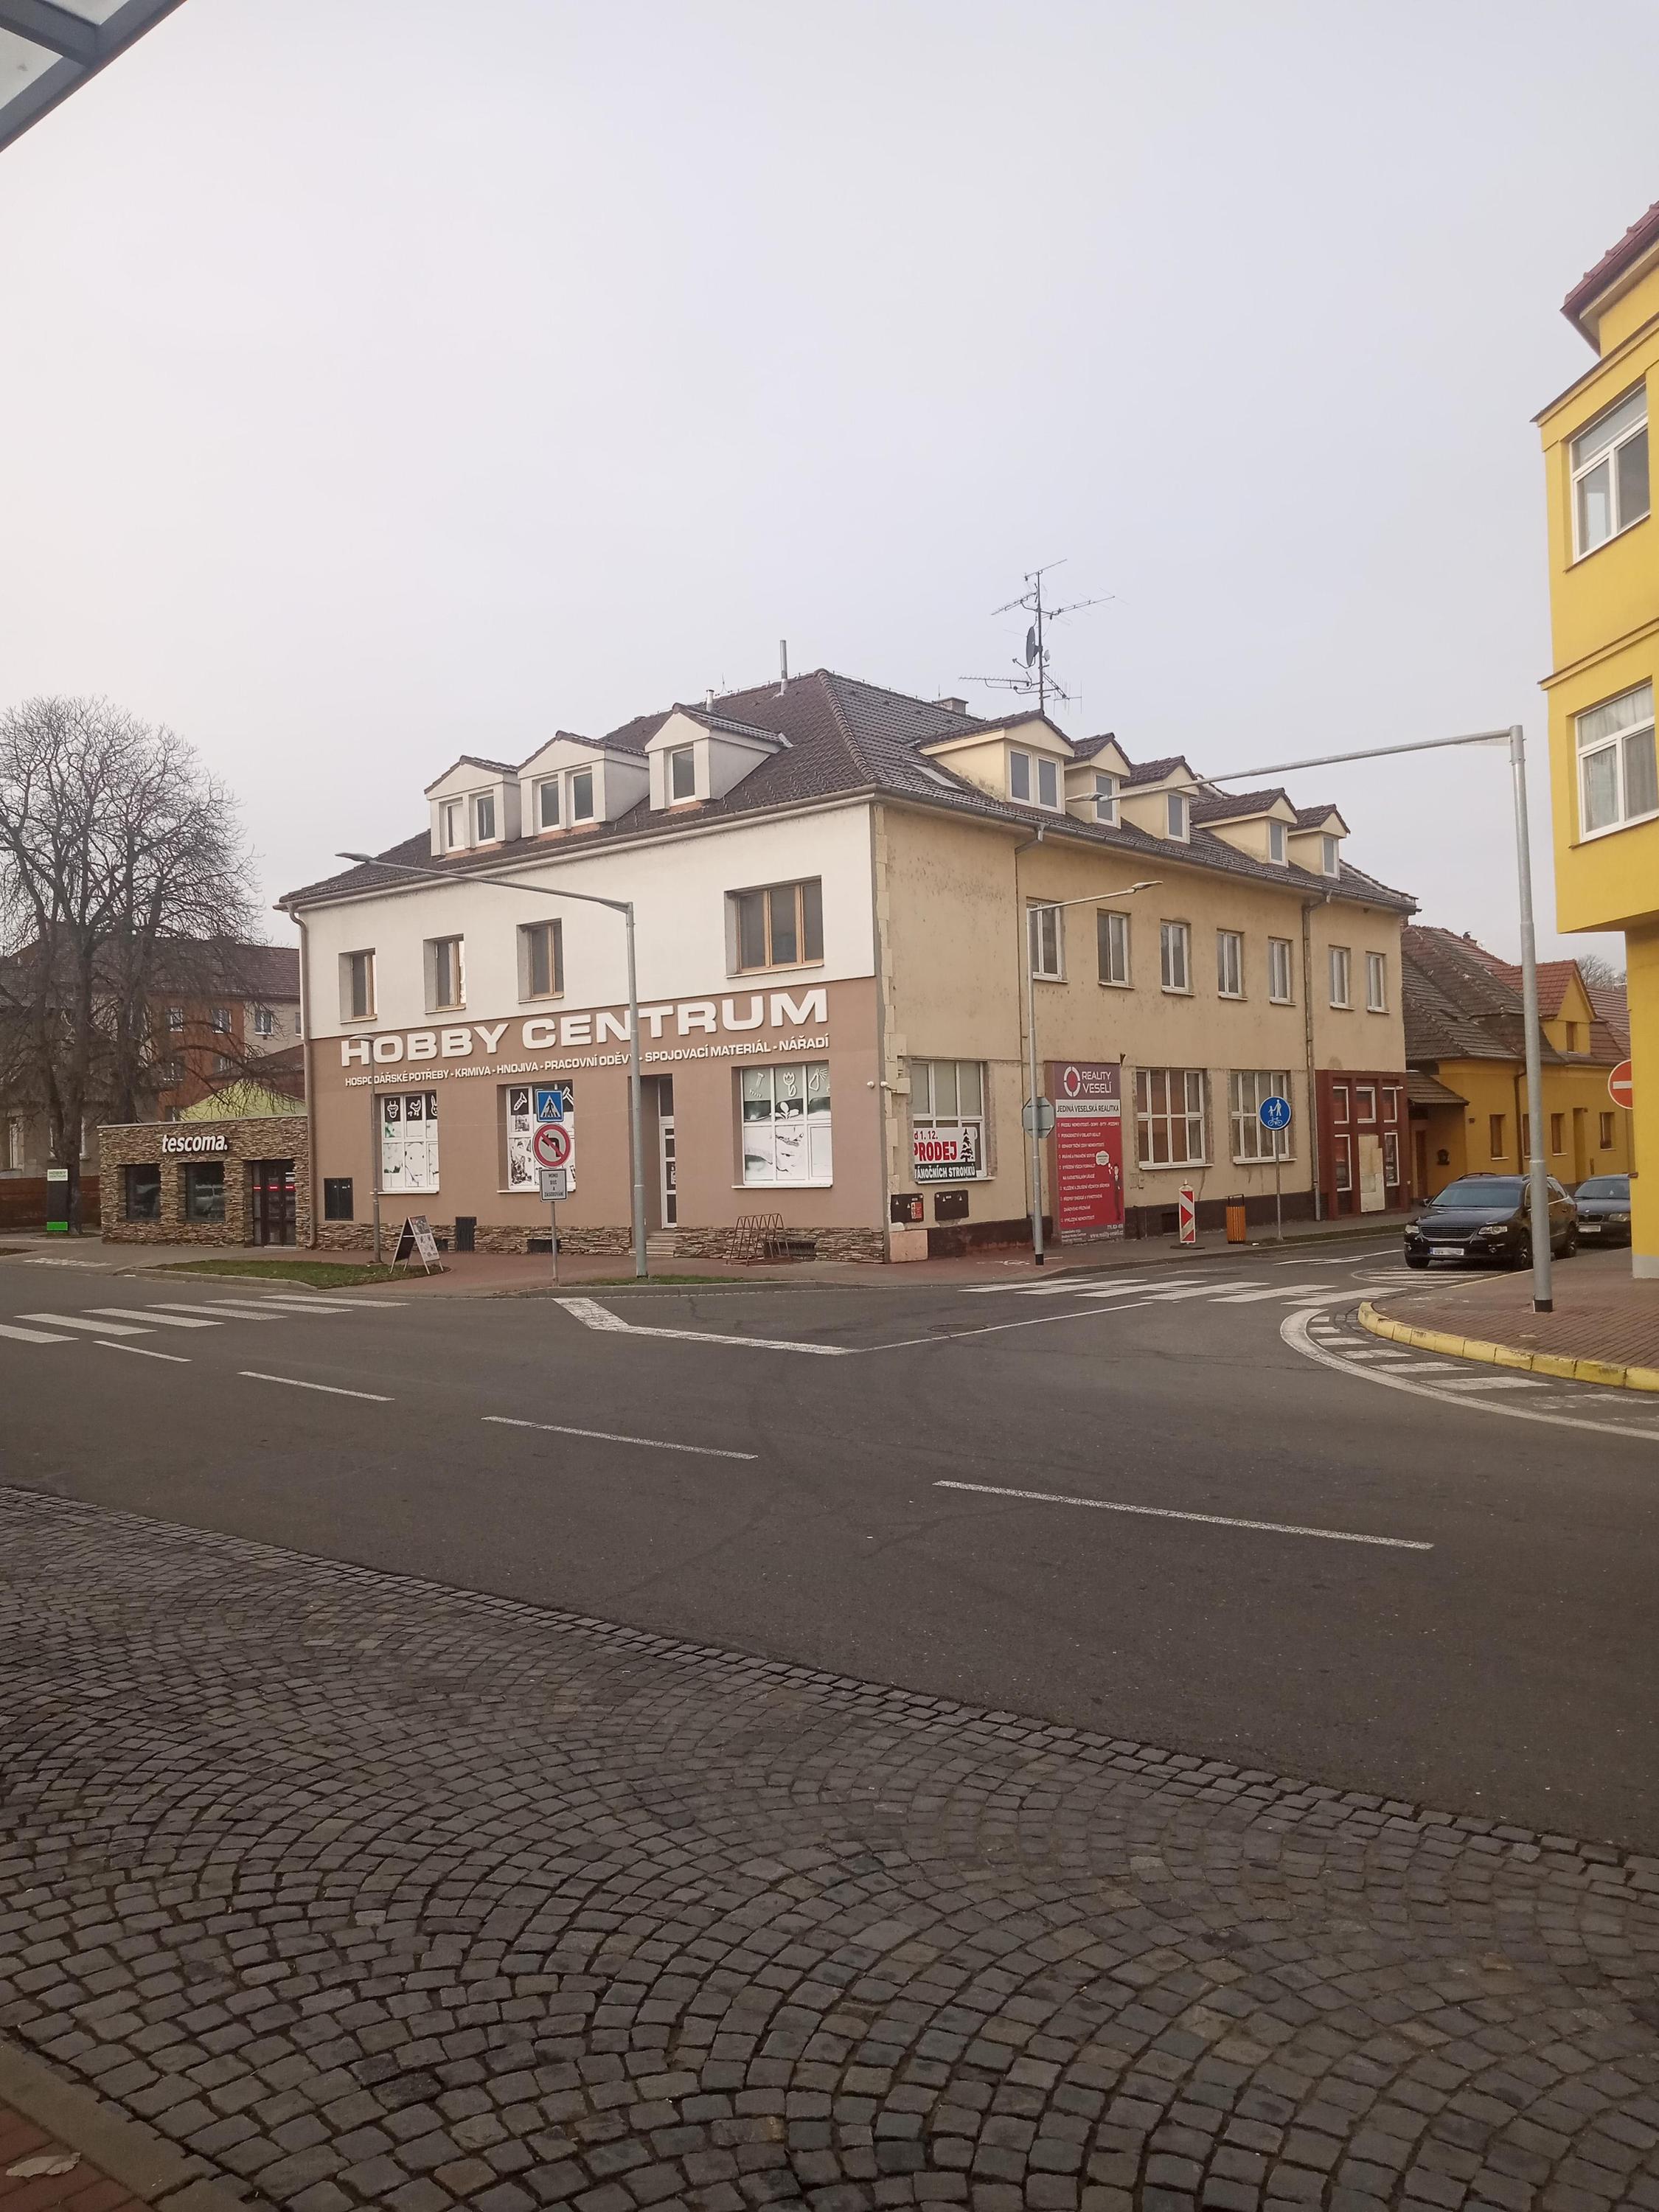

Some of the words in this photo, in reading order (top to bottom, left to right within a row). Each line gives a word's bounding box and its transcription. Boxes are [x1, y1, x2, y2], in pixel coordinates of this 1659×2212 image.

[341, 1023, 509, 1066] HOBBY
[522, 989, 828, 1049] CENTRUM
[409, 1068, 449, 1082] POTŘEBY
[455, 1066, 491, 1078] KRMIVA
[497, 1062, 538, 1074] HNOJIVA
[544, 1054, 597, 1070] PRACOVNÍ
[599, 1051, 632, 1066] ODĚV
[645, 1044, 709, 1062] SPOJOVACÍ
[711, 1039, 771, 1057] MATERIÁL
[779, 1033, 829, 1051] NÁŘADÍ
[1082, 1071, 1111, 1080] REALITY
[1082, 1082, 1112, 1093] VESELÍ
